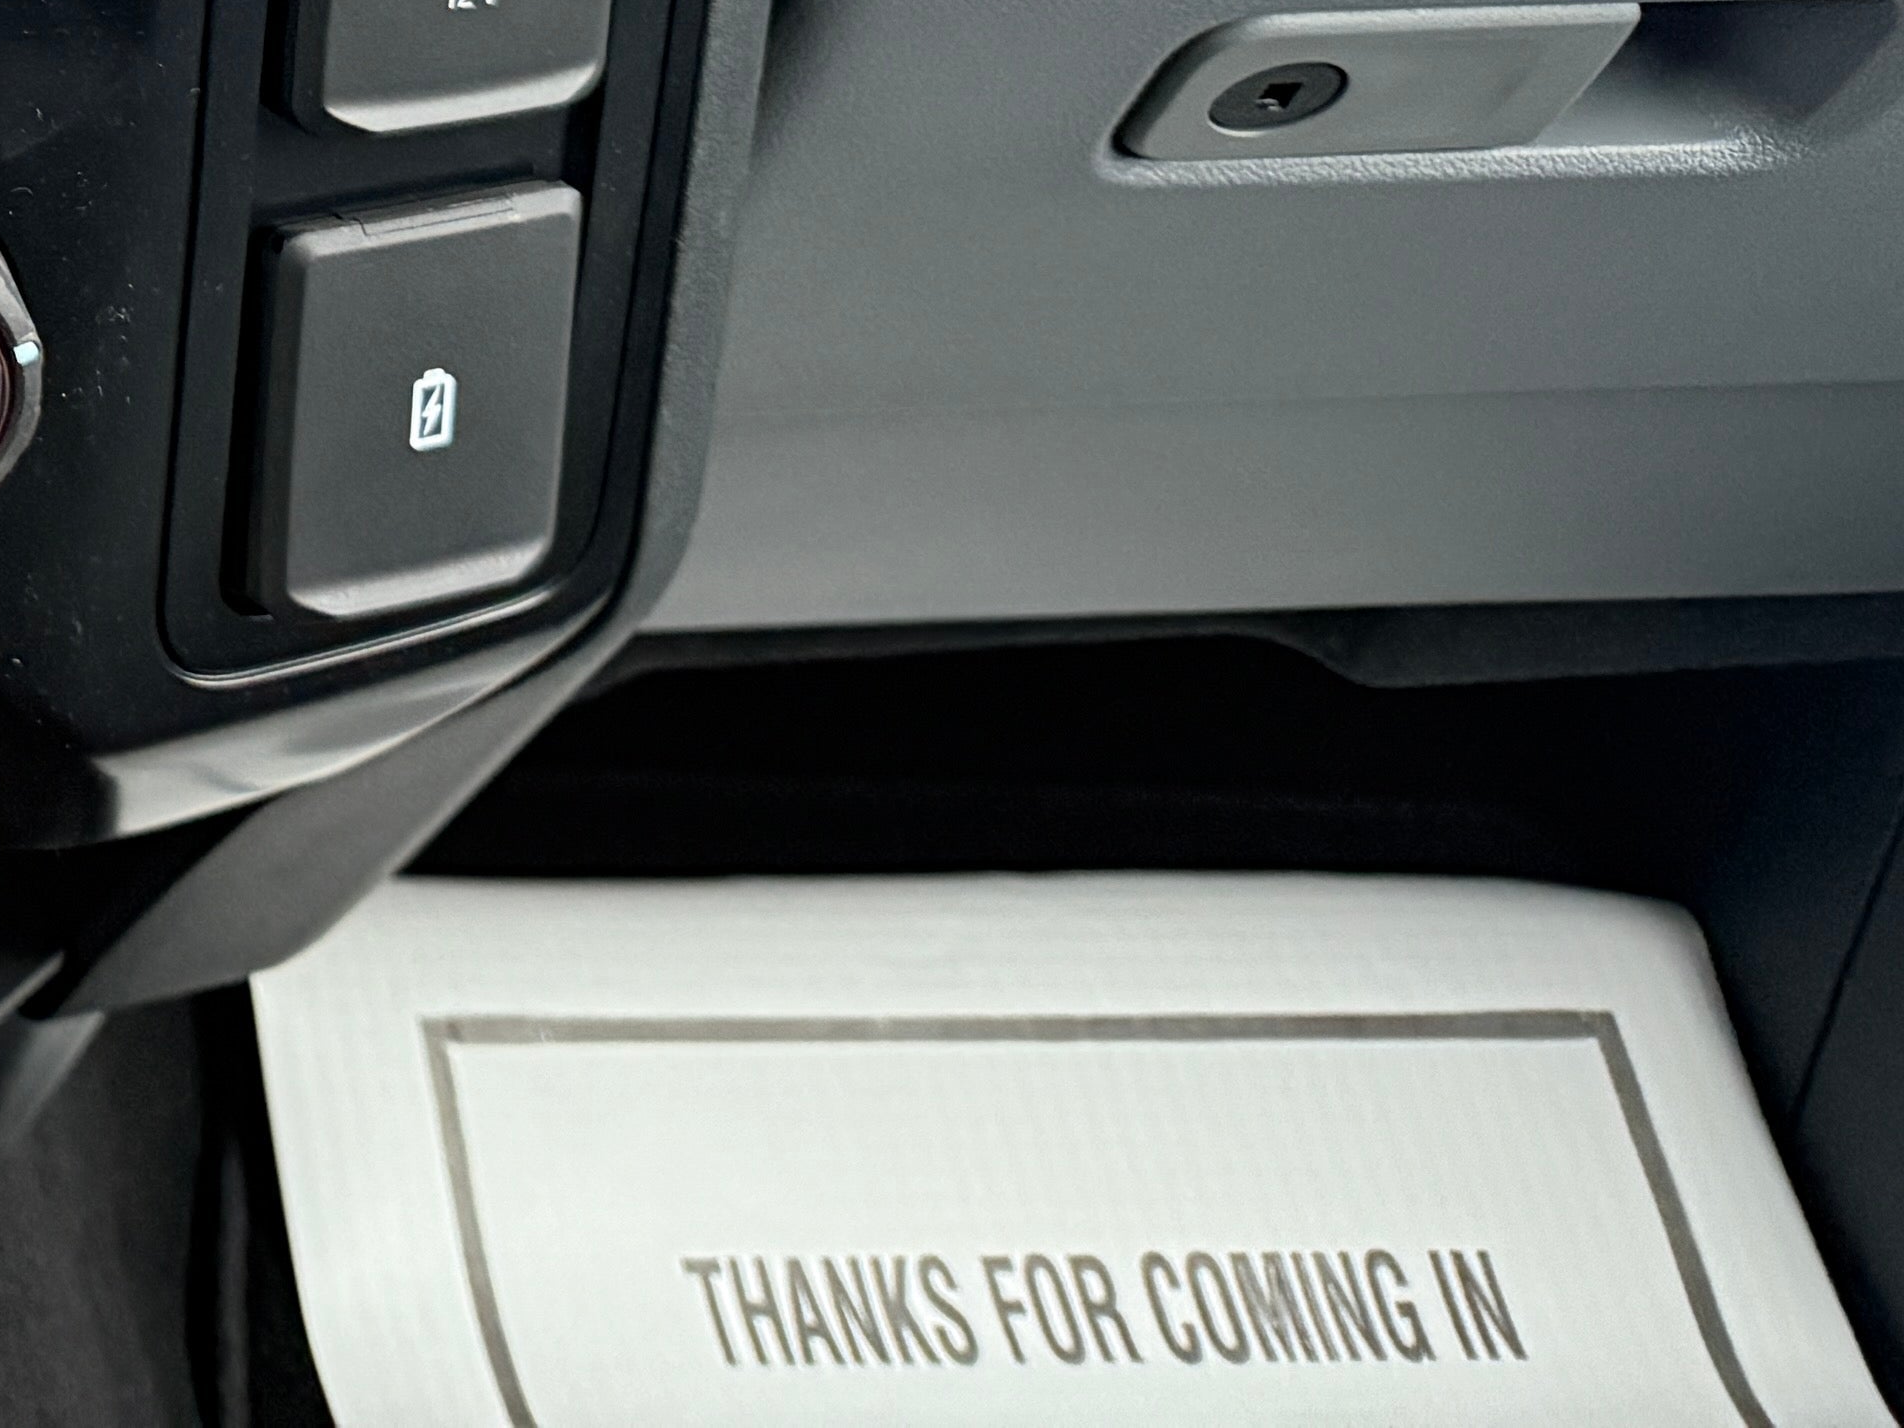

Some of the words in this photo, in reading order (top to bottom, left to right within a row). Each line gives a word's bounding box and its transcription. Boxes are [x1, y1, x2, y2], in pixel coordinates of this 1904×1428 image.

[682, 1254, 979, 1367] THANKS
[982, 1252, 1142, 1365] FOR
[1138, 1248, 1436, 1365] COMING
[1428, 1248, 1529, 1362] IN
